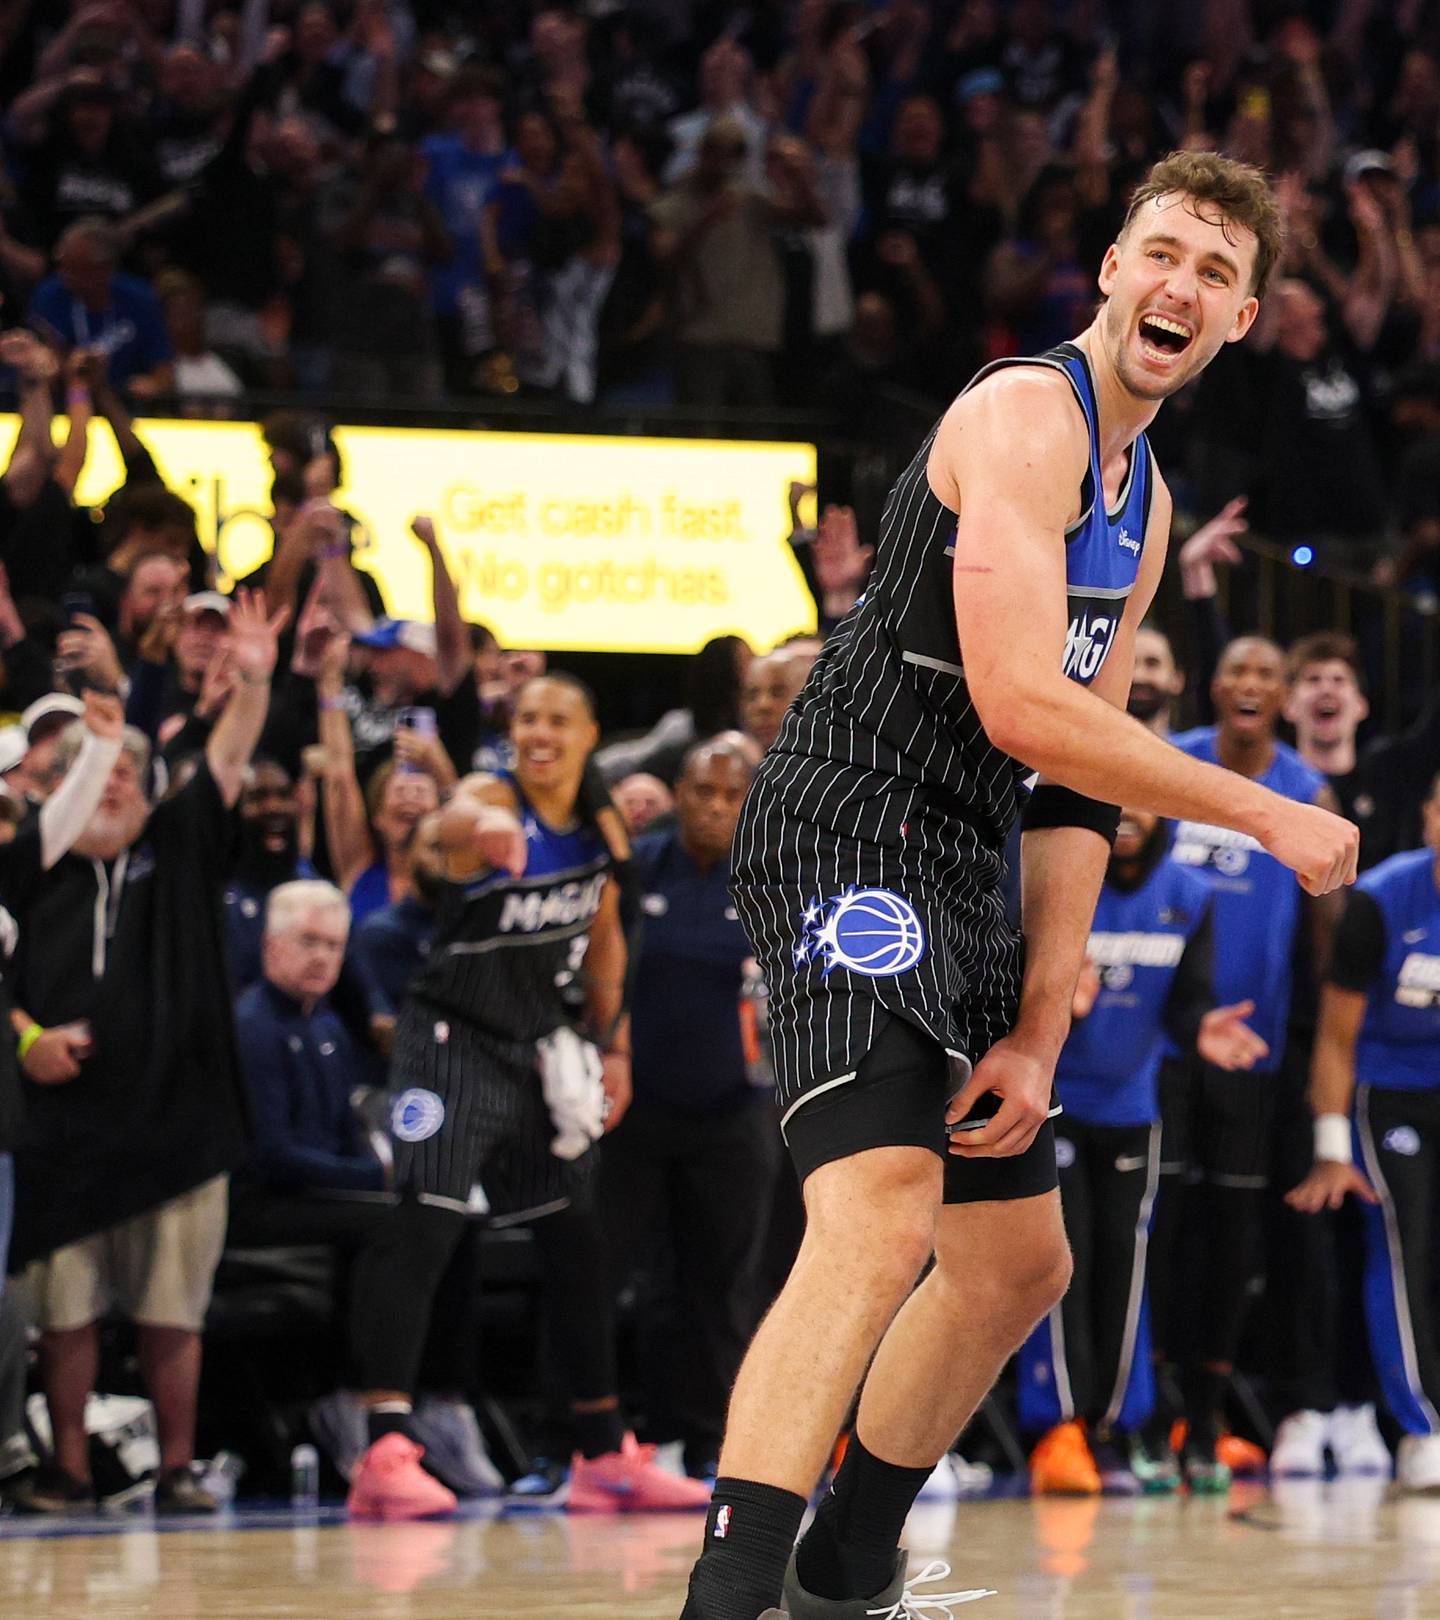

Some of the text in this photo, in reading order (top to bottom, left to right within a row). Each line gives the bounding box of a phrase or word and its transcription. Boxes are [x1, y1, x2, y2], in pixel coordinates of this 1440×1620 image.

[444, 482, 526, 533] Get
[541, 489, 652, 537] cash
[1118, 526, 1141, 557] Disney
[457, 549, 528, 599] No
